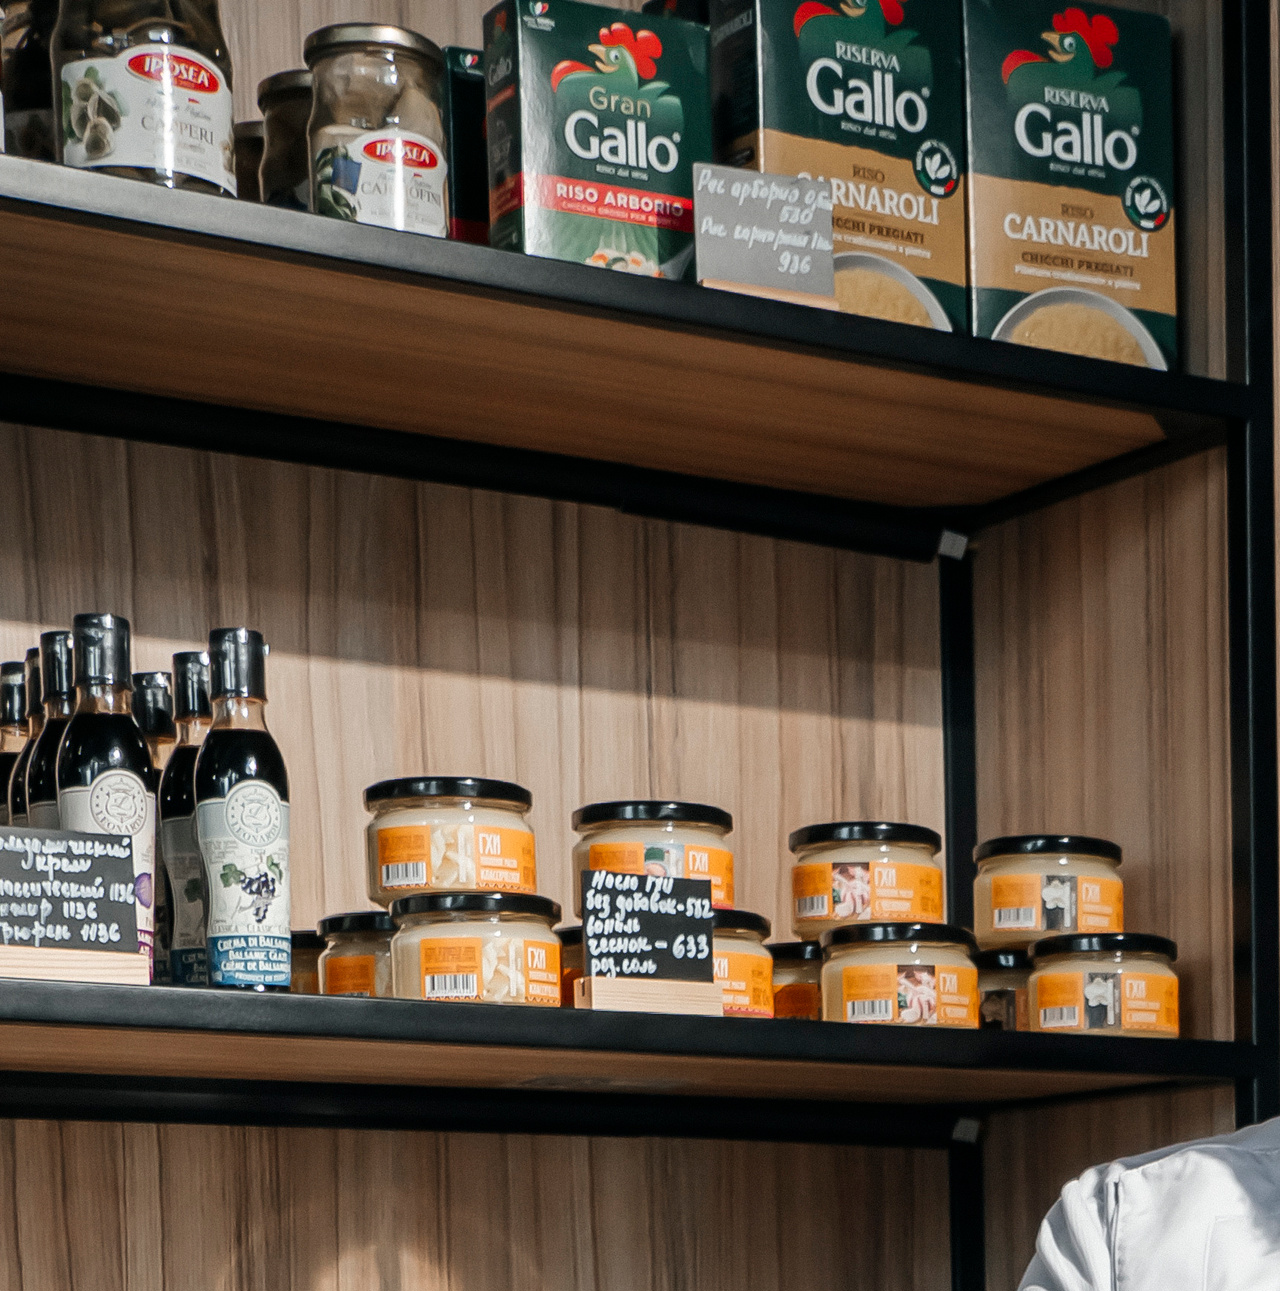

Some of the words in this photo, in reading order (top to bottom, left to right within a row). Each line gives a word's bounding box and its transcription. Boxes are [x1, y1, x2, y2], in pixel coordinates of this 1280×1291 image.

[836, 40, 900, 72] RISERVA
[589, 85, 651, 118] Gran
[806, 57, 928, 133] Gallo
[1044, 86, 1110, 113] RISERVA
[564, 109, 679, 173] Gallo
[1014, 102, 1137, 170] Gallo
[376, 142, 430, 165] IPSEA
[853, 164, 885, 183] RISO
[556, 182, 599, 203] RISO
[604, 191, 684, 216] ARBORIO
[798, 171, 939, 225] RNAROLI
[1003, 213, 1149, 258] CARNAROLI
[479, 833, 501, 855] ГХИ
[689, 851, 708, 871] ГХИ
[527, 946, 546, 970] ГХИ
[672, 933, 709, 959] 633
[714, 957, 729, 978] ХИ
